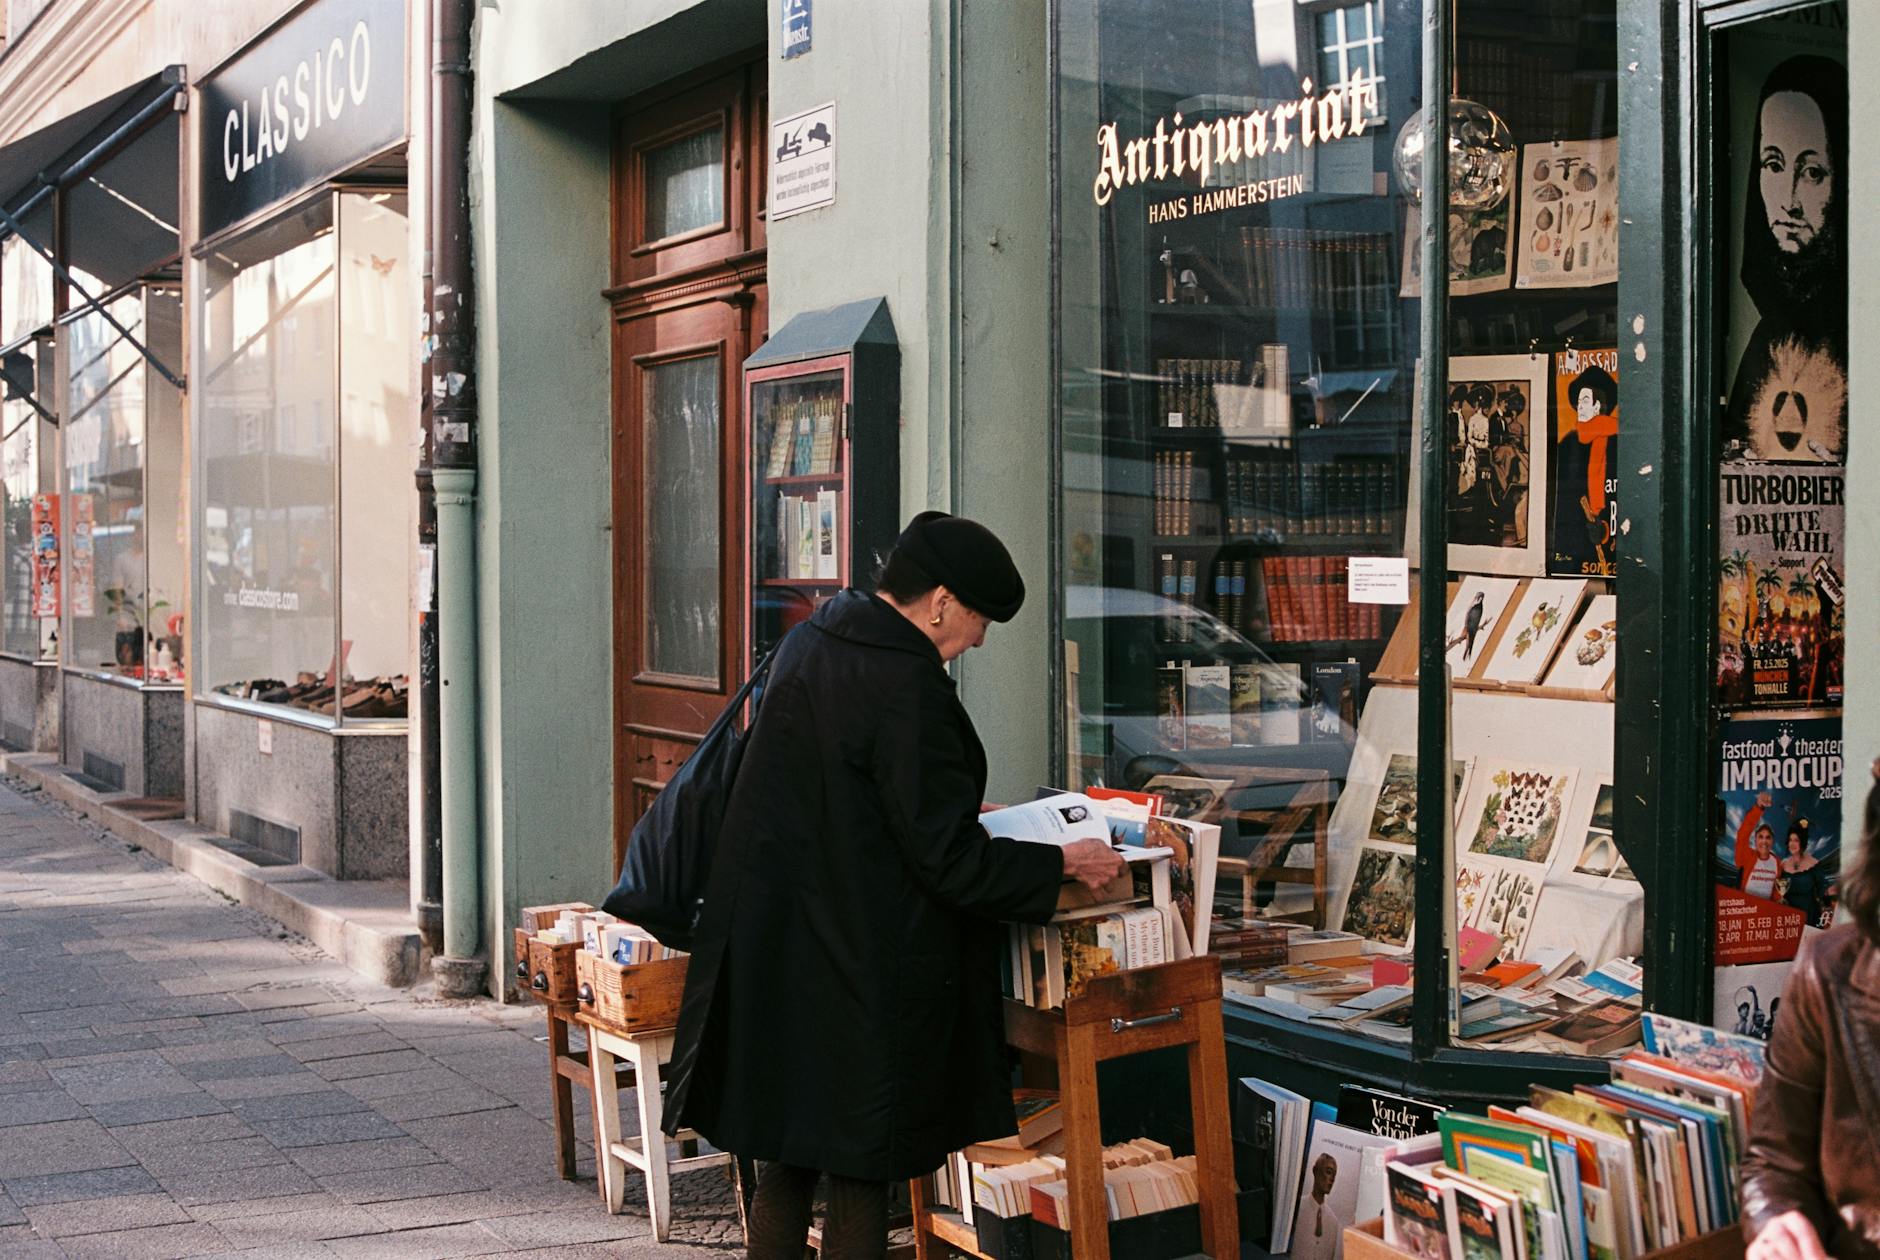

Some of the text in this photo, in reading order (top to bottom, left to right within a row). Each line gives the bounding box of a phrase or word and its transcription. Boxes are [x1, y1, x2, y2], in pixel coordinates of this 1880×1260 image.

[223, 21, 370, 182] CLASSICO
[1094, 67, 1376, 206] Antiquariat
[1149, 175, 1303, 224] HANS HAMMERSTEIN
[1721, 474, 1845, 505] TURBOBIER
[1735, 511, 1820, 536] DRITTE
[1772, 531, 1834, 553] WAHL
[1778, 556, 1805, 568] Support
[1754, 683, 1788, 695] TONHALLE
[1722, 738, 1842, 759] fastfood theater
[1722, 756, 1843, 791] IMPROCUP
[1819, 787, 1842, 799] 2025
[1372, 1098, 1419, 1127] Von der
